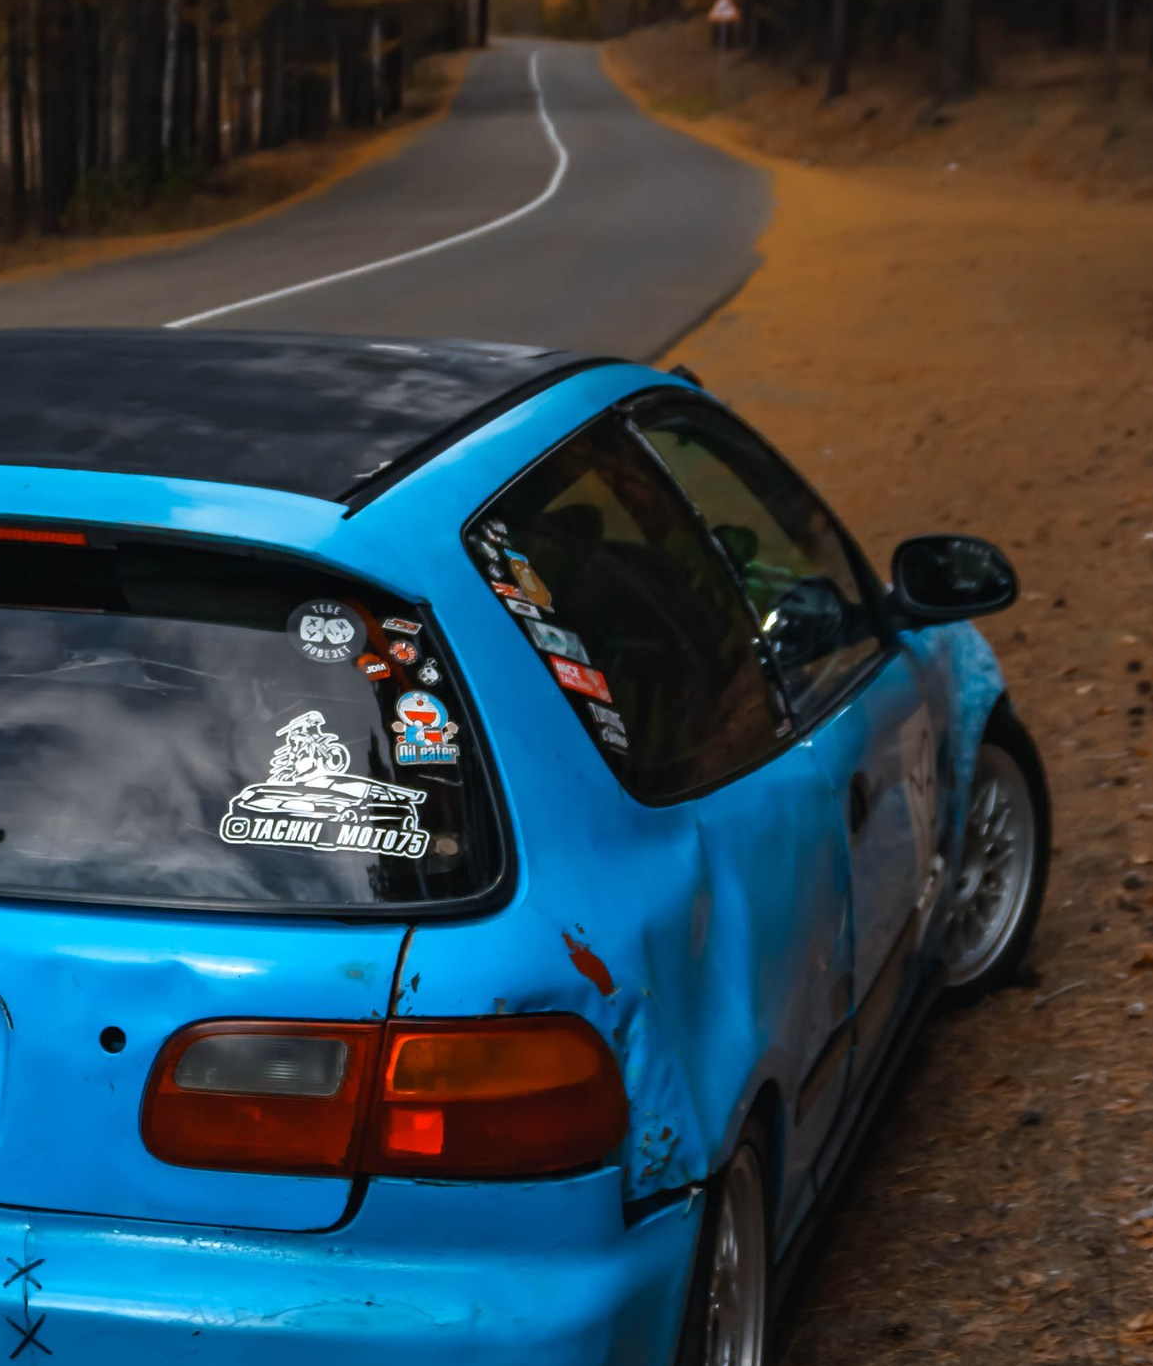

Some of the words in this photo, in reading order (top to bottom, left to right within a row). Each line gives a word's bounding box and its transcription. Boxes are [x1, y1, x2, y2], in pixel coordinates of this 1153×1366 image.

[312, 604, 342, 615] ТЕБЕ
[302, 643, 351, 659] ПОВЕЗЕТ
[366, 663, 387, 674] JDM
[399, 744, 417, 762] Oil
[420, 744, 457, 762] eater
